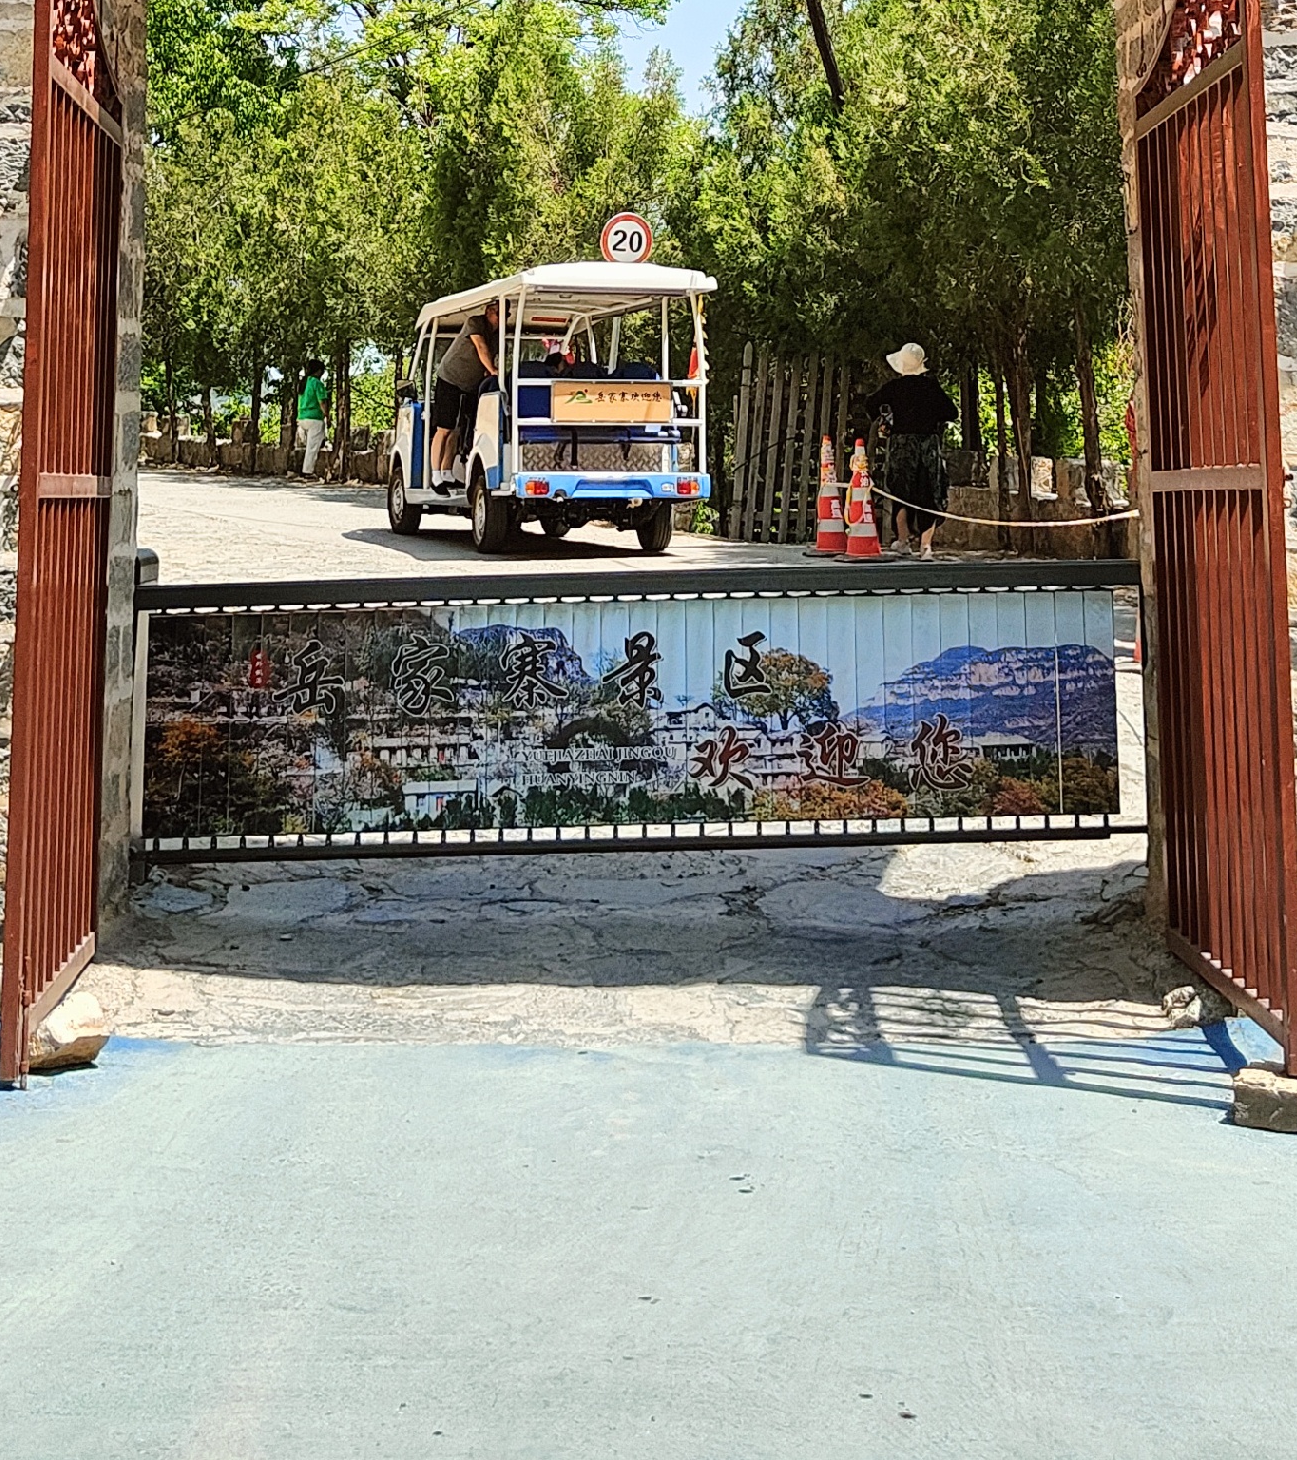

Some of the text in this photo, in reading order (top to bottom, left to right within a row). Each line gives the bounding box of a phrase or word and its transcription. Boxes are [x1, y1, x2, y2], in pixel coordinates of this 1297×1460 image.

[612, 229, 643, 253] 20
[273, 630, 772, 716] 岳家寨景区
[616, 746, 677, 763] JINGQU
[692, 715, 972, 790] 欢迎您
